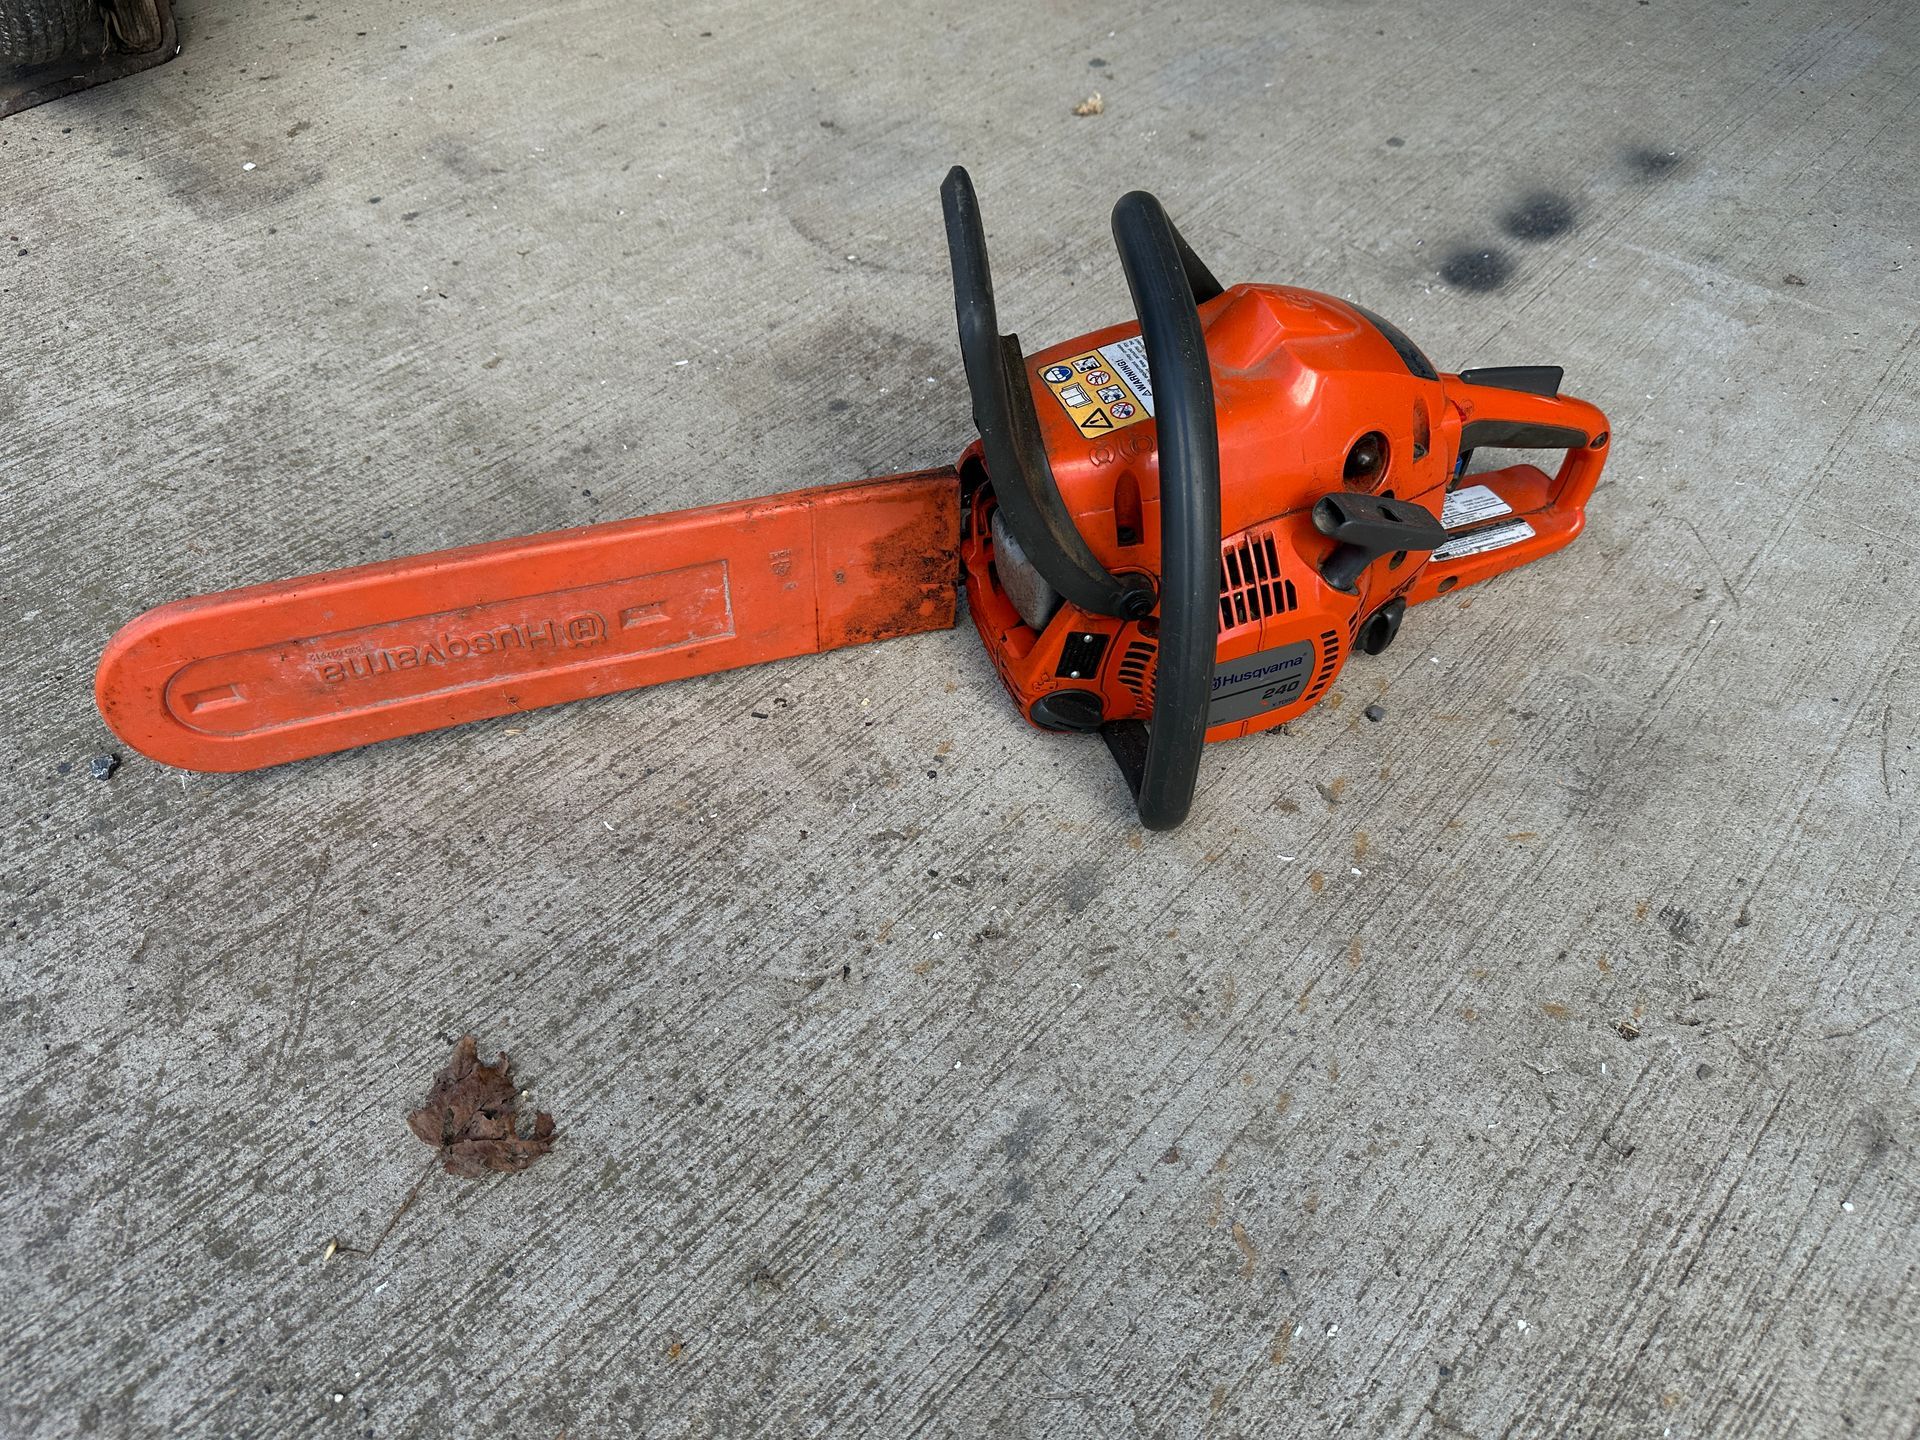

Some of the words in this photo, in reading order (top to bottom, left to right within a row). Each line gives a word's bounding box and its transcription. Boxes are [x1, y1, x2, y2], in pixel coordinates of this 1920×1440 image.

[1115, 358, 1146, 392] WARNING!
[314, 619, 556, 686] Husqvarna
[1222, 657, 1303, 687] Husqvarna
[1262, 681, 1301, 700] 240
